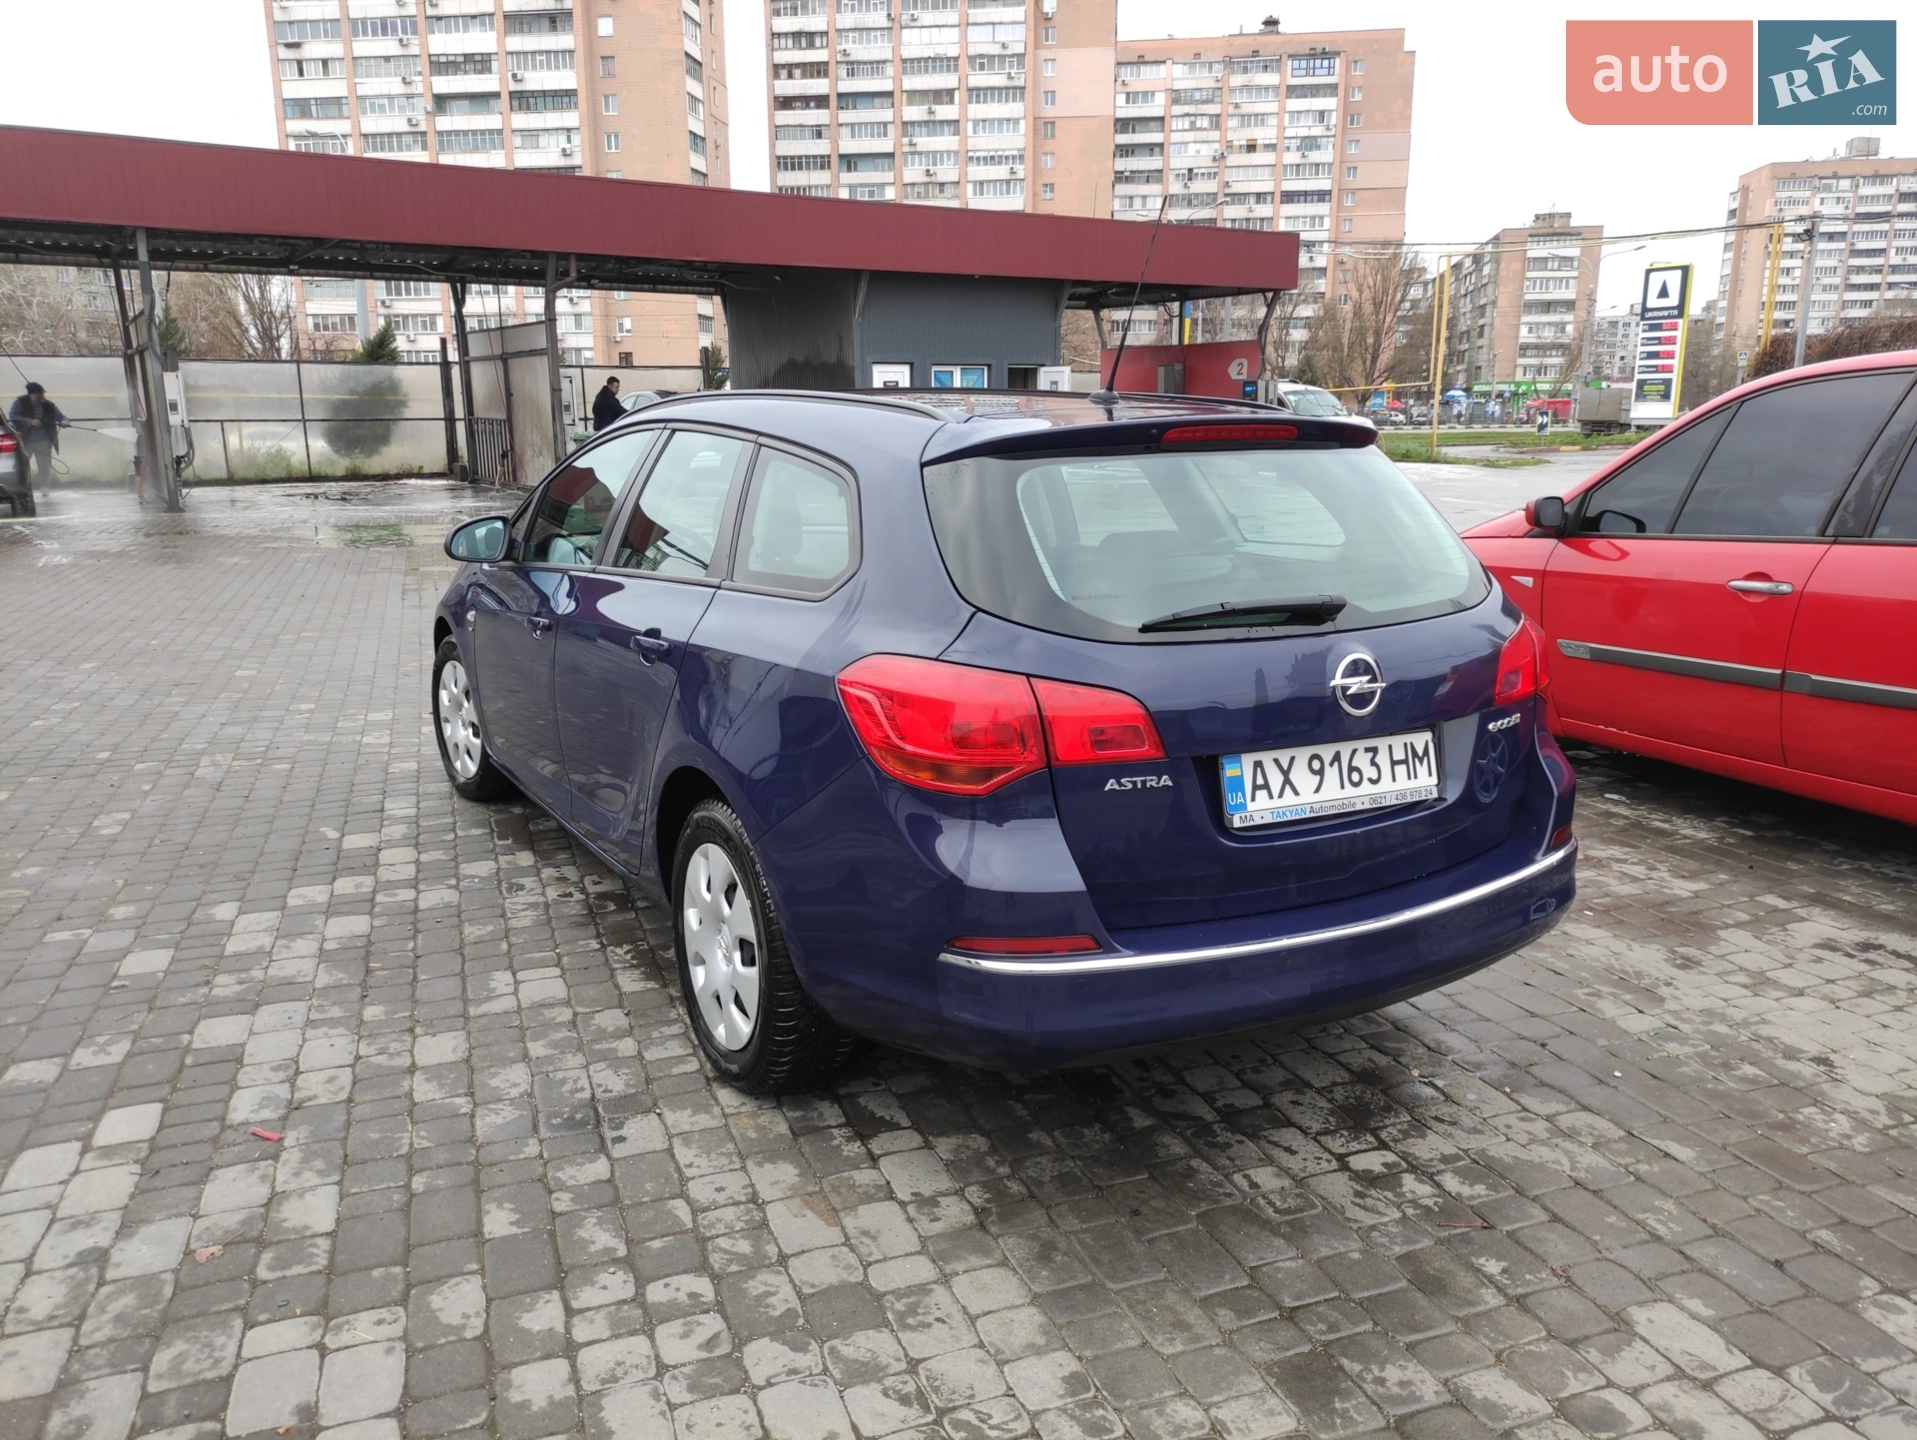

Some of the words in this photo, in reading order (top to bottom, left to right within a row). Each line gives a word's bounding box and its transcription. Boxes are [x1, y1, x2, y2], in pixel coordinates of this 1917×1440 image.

[1236, 362, 1244, 376] 2
[1250, 755, 1301, 803] AX
[1307, 746, 1383, 795] 9163
[1388, 739, 1433, 783] HM
[1103, 775, 1174, 791] ASTRA
[1228, 791, 1245, 806] UA
[1239, 814, 1255, 824] MA
[1270, 807, 1307, 821] TAKYAN
[1308, 801, 1357, 815] Automobile
[1369, 795, 1388, 806] 0621
[1395, 791, 1408, 802] 436
[1409, 789, 1423, 799] 978
[1424, 788, 1433, 797] 24
